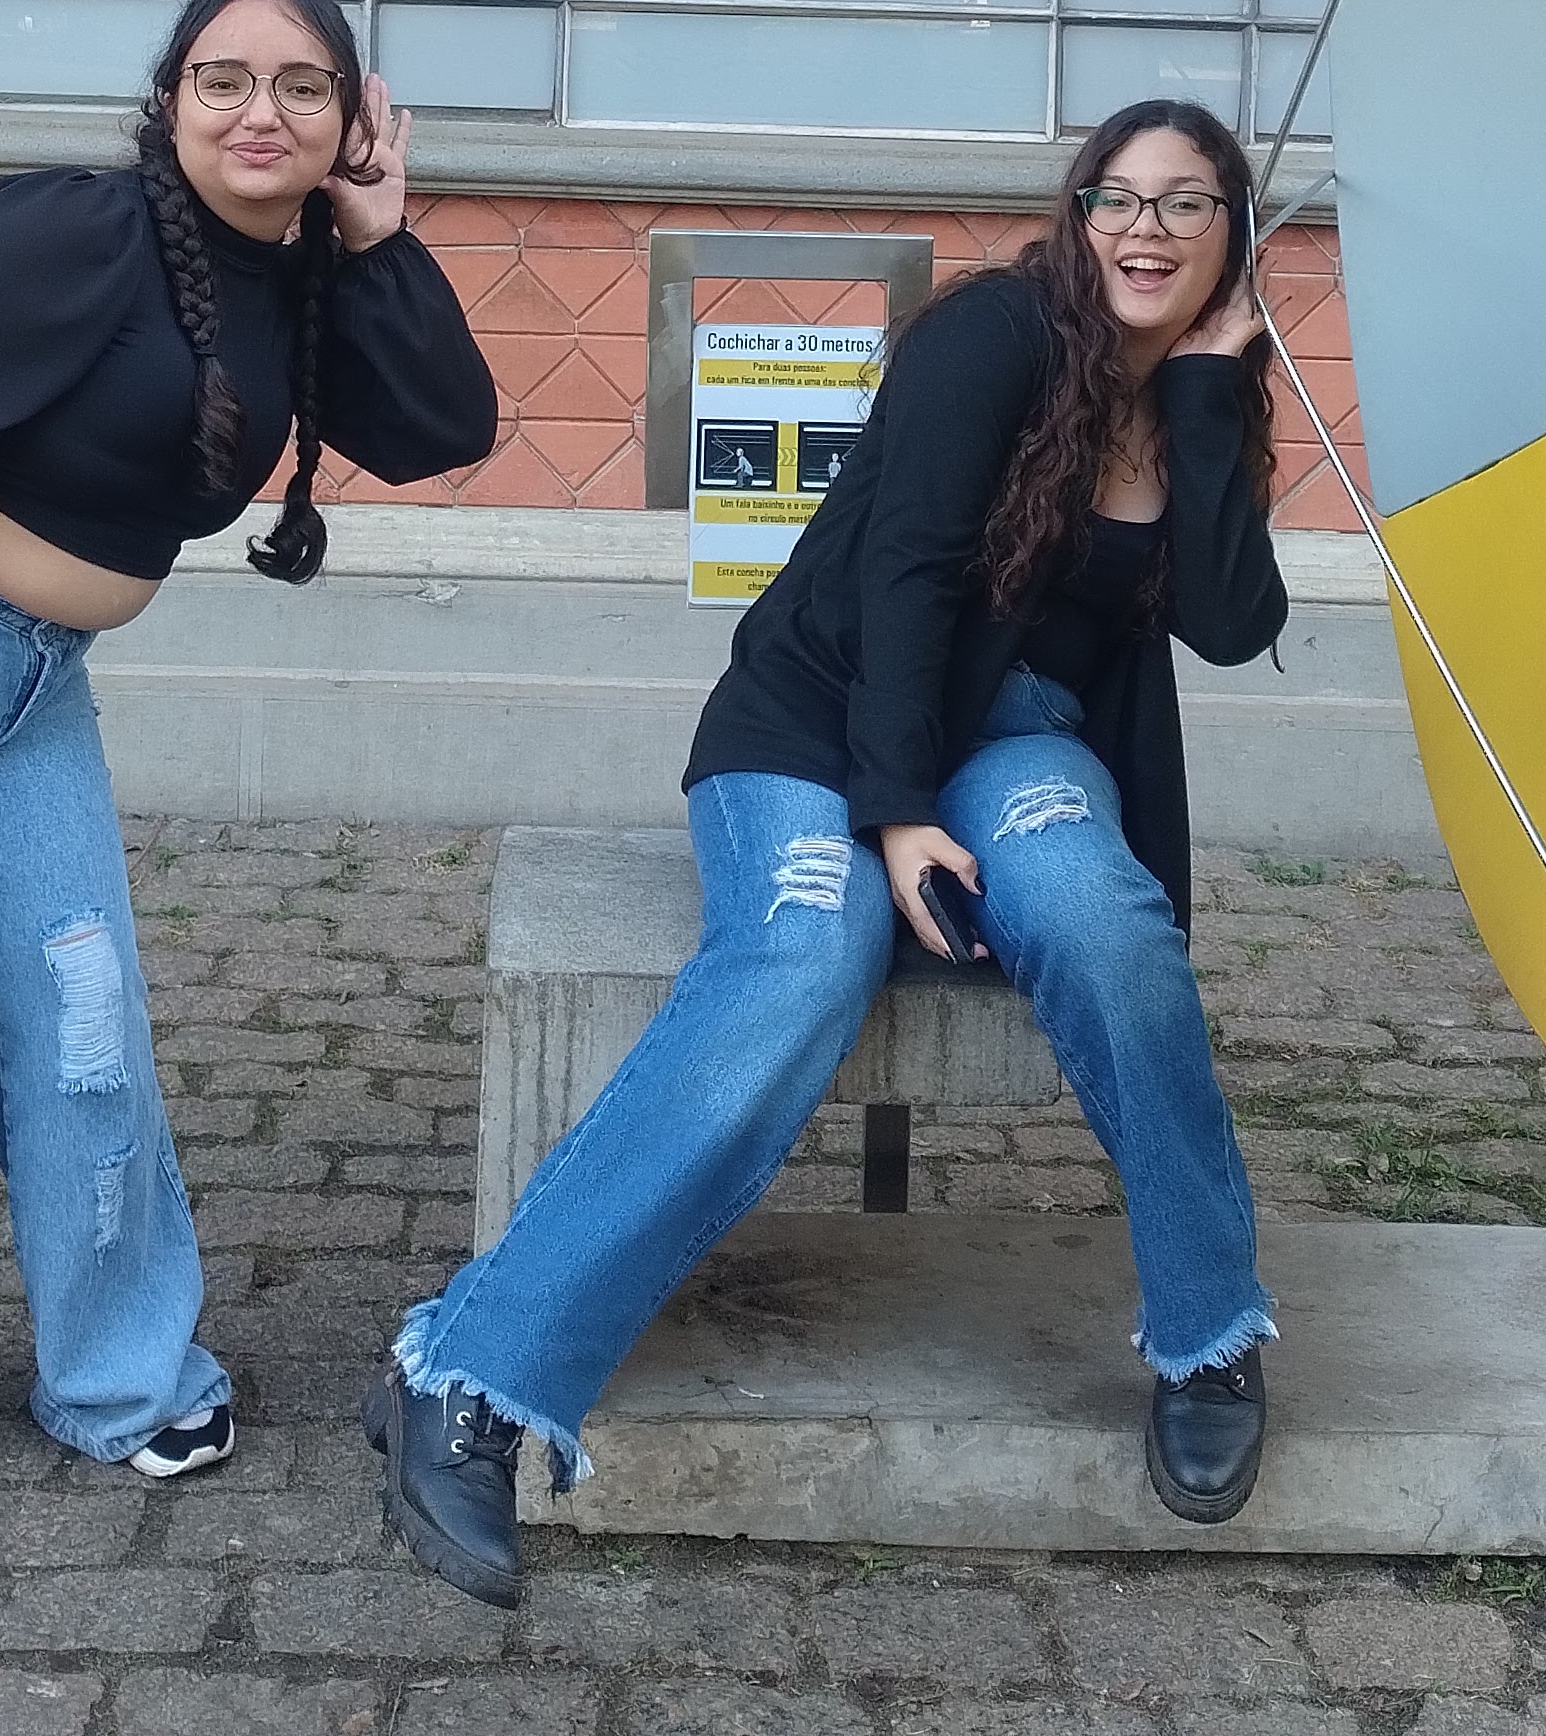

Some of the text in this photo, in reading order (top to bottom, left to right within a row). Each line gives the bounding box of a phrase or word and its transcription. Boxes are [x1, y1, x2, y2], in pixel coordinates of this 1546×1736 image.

[707, 332, 873, 353] Cochichar a 30 metros
[753, 362, 827, 374] Para duas pessoas:
[706, 374, 725, 384] cada
[727, 376, 739, 384] um
[741, 374, 755, 385] fica
[758, 377, 770, 385] em
[772, 376, 796, 386] frente
[805, 378, 821, 386] uma
[823, 377, 837, 387] das
[720, 498, 734, 508] Um
[736, 498, 751, 508] fala
[753, 499, 785, 509] baixinho
[748, 515, 758, 523] no
[717, 566, 735, 577] Esta
[736, 567, 764, 577] concha
